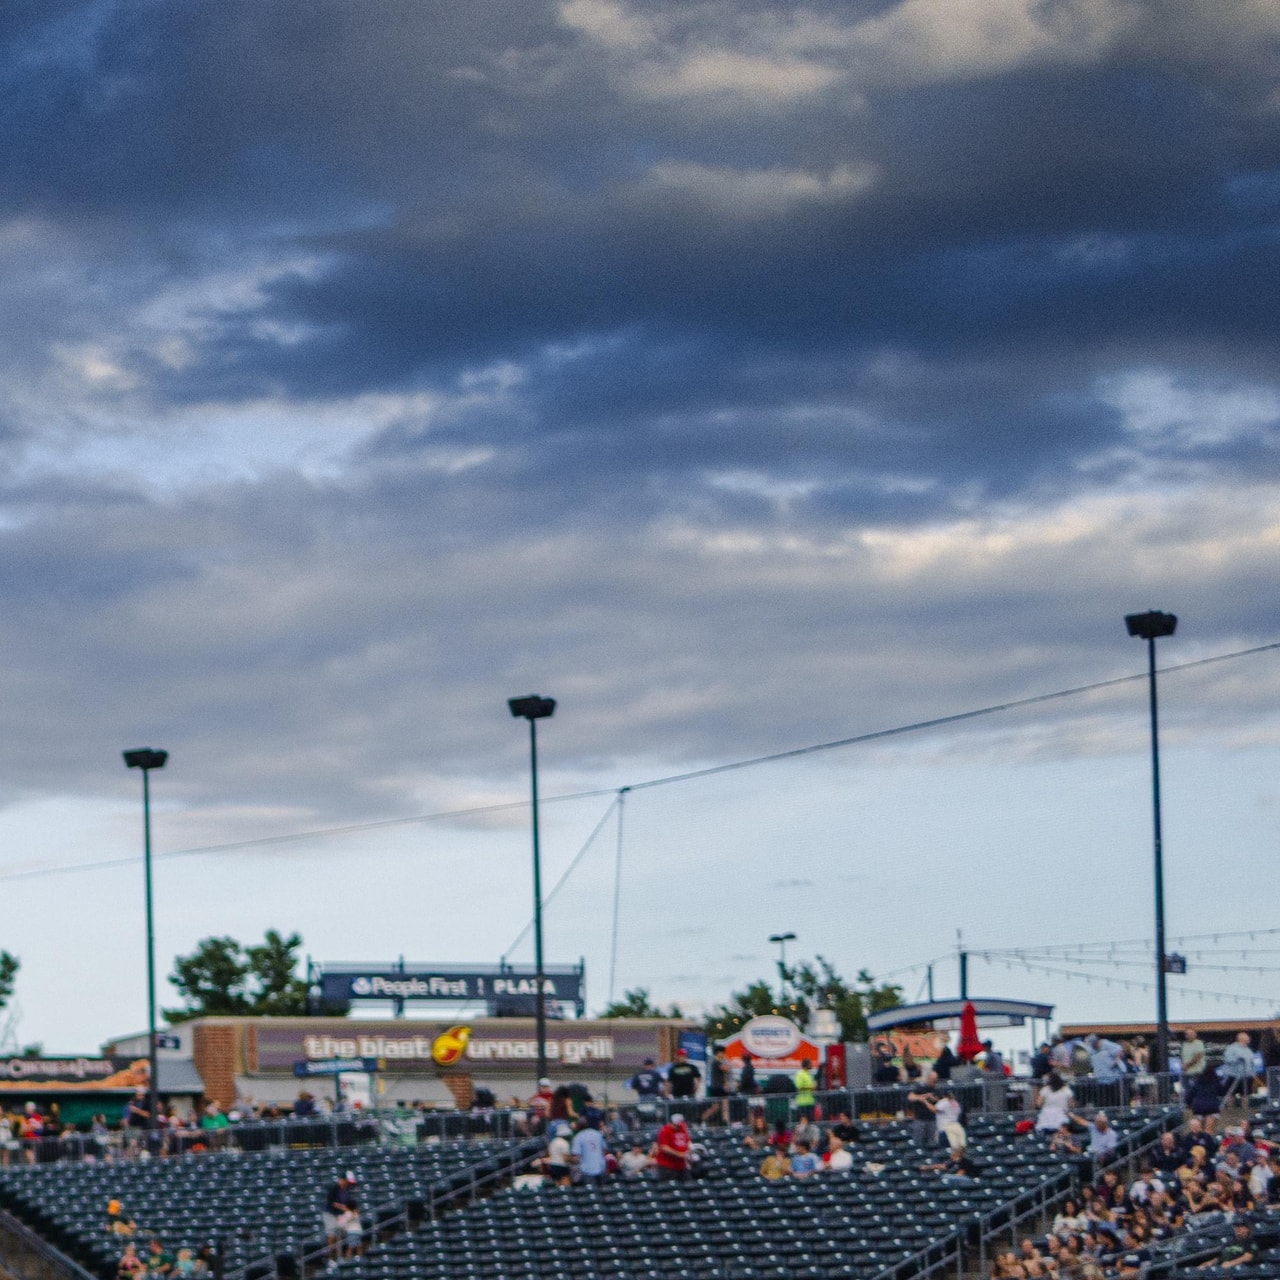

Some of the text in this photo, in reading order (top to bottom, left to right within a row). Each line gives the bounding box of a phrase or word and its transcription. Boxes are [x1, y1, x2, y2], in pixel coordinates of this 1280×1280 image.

[371, 976, 428, 997] People
[429, 976, 467, 996] First
[305, 1033, 357, 1059] the
[358, 1033, 430, 1059] blast
[561, 1035, 615, 1064] grill
